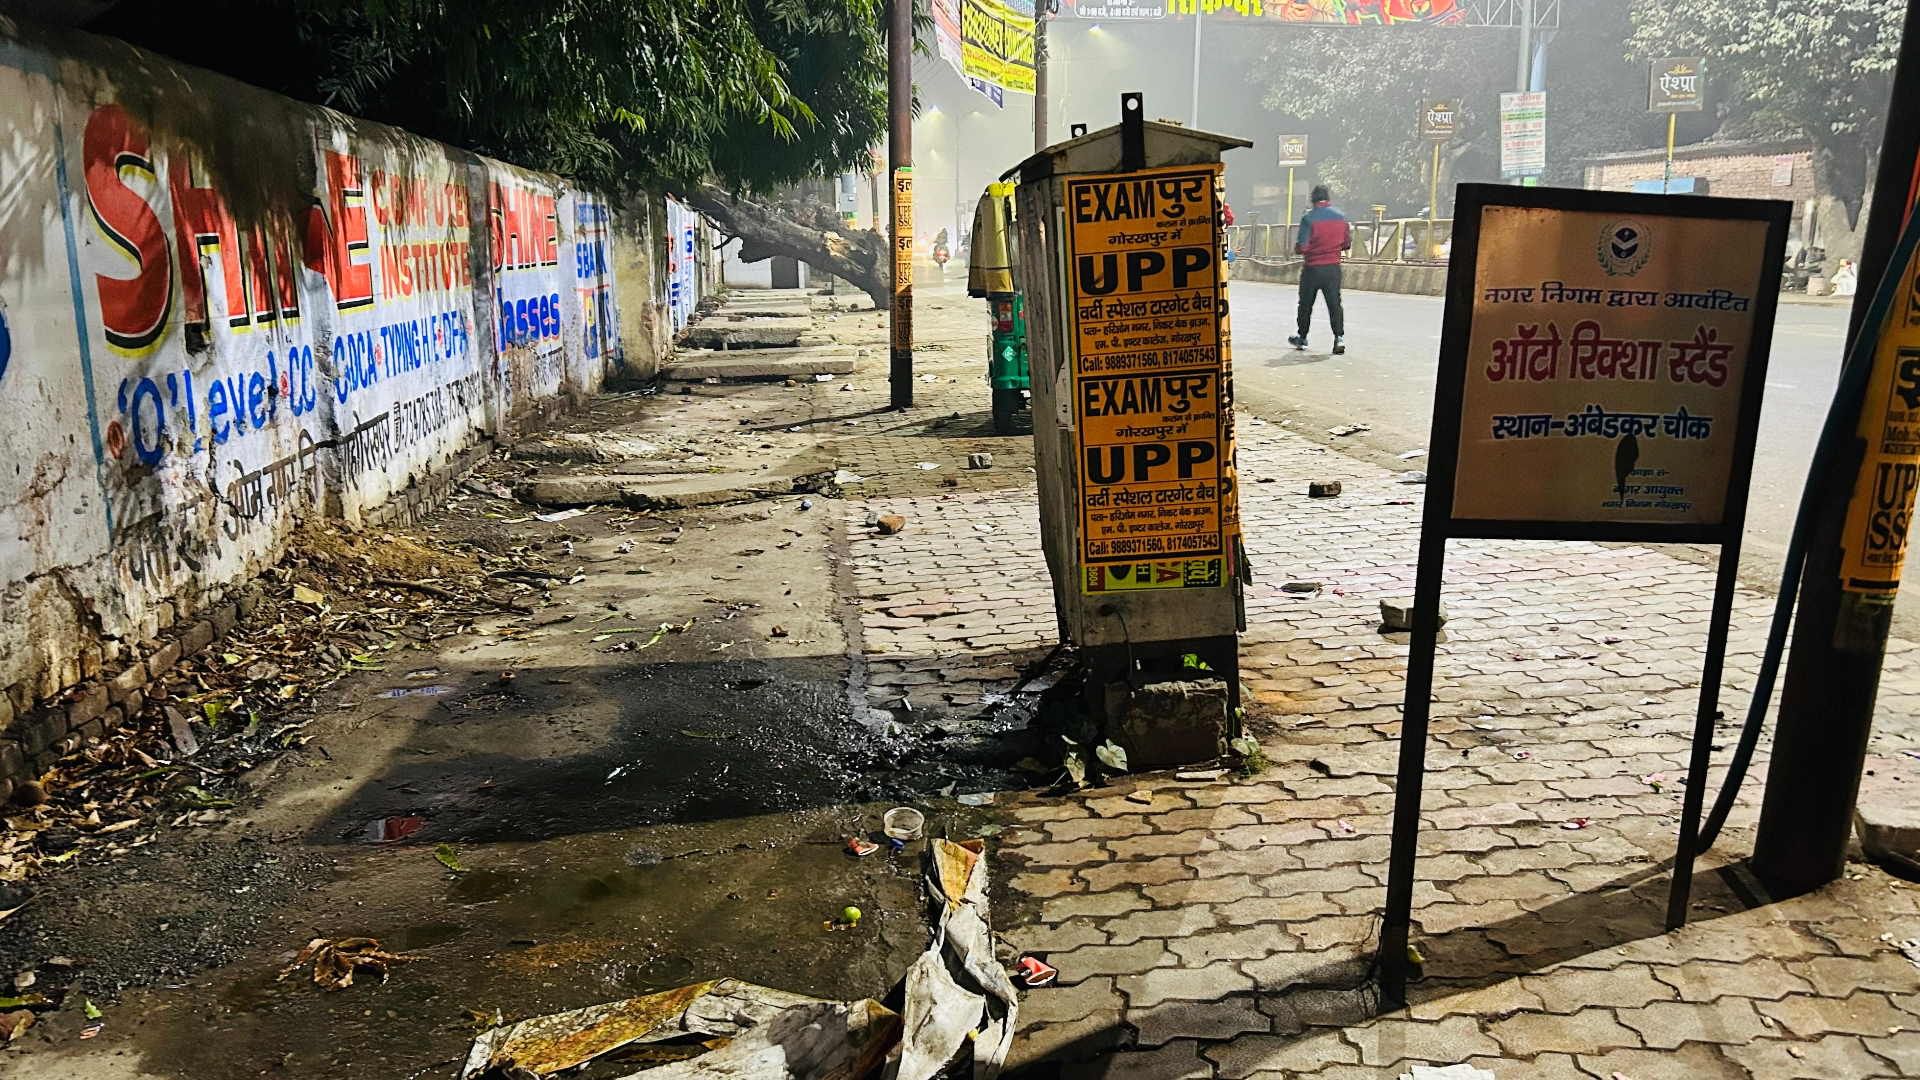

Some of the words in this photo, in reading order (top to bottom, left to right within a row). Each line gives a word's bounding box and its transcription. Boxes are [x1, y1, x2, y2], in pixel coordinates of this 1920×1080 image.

[1108, 231, 1168, 249] गोरखपुर
[1170, 227, 1184, 242] में
[381, 241, 471, 299] INSTITUTE
[1078, 247, 1211, 296] UPP
[1080, 299, 1103, 321] वर्दी
[1106, 297, 1149, 319] स्पेशल
[1150, 293, 1189, 315] टारगेट
[1485, 287, 1535, 304] नगर
[1541, 281, 1602, 305] निगम
[1607, 290, 1659, 309] द्वारा
[1664, 288, 1749, 312] आवंटित
[381, 318, 421, 378] TYPING
[1487, 323, 1561, 381] ऑटो
[1570, 321, 1660, 381] रिक्शा
[1668, 326, 1733, 388] स्टैंड
[1082, 355, 1103, 372] Call:
[1115, 425, 1170, 440] गोरखपुर
[1172, 421, 1187, 435] में
[1087, 441, 1215, 485] UPP
[1087, 487, 1110, 508] वर्दी
[1114, 486, 1152, 507] स्पेशल
[1155, 482, 1194, 503] टारगेट
[1088, 540, 1110, 556] Call:
